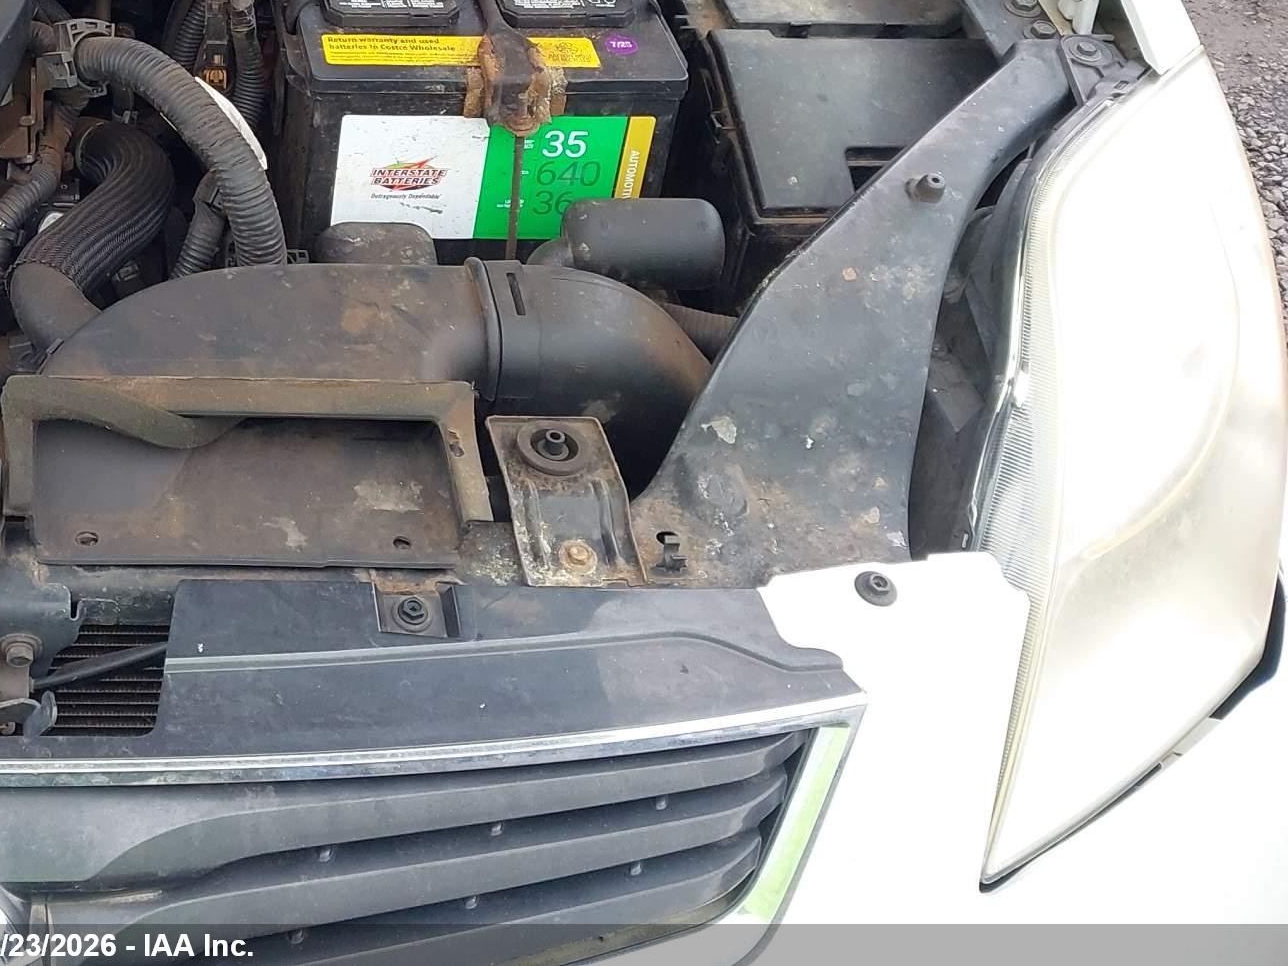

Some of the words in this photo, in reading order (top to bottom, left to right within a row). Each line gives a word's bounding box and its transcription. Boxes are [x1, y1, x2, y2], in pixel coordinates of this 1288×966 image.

[542, 130, 589, 157] 35
[372, 177, 440, 185] BATTERIES
[537, 161, 601, 187] 640
